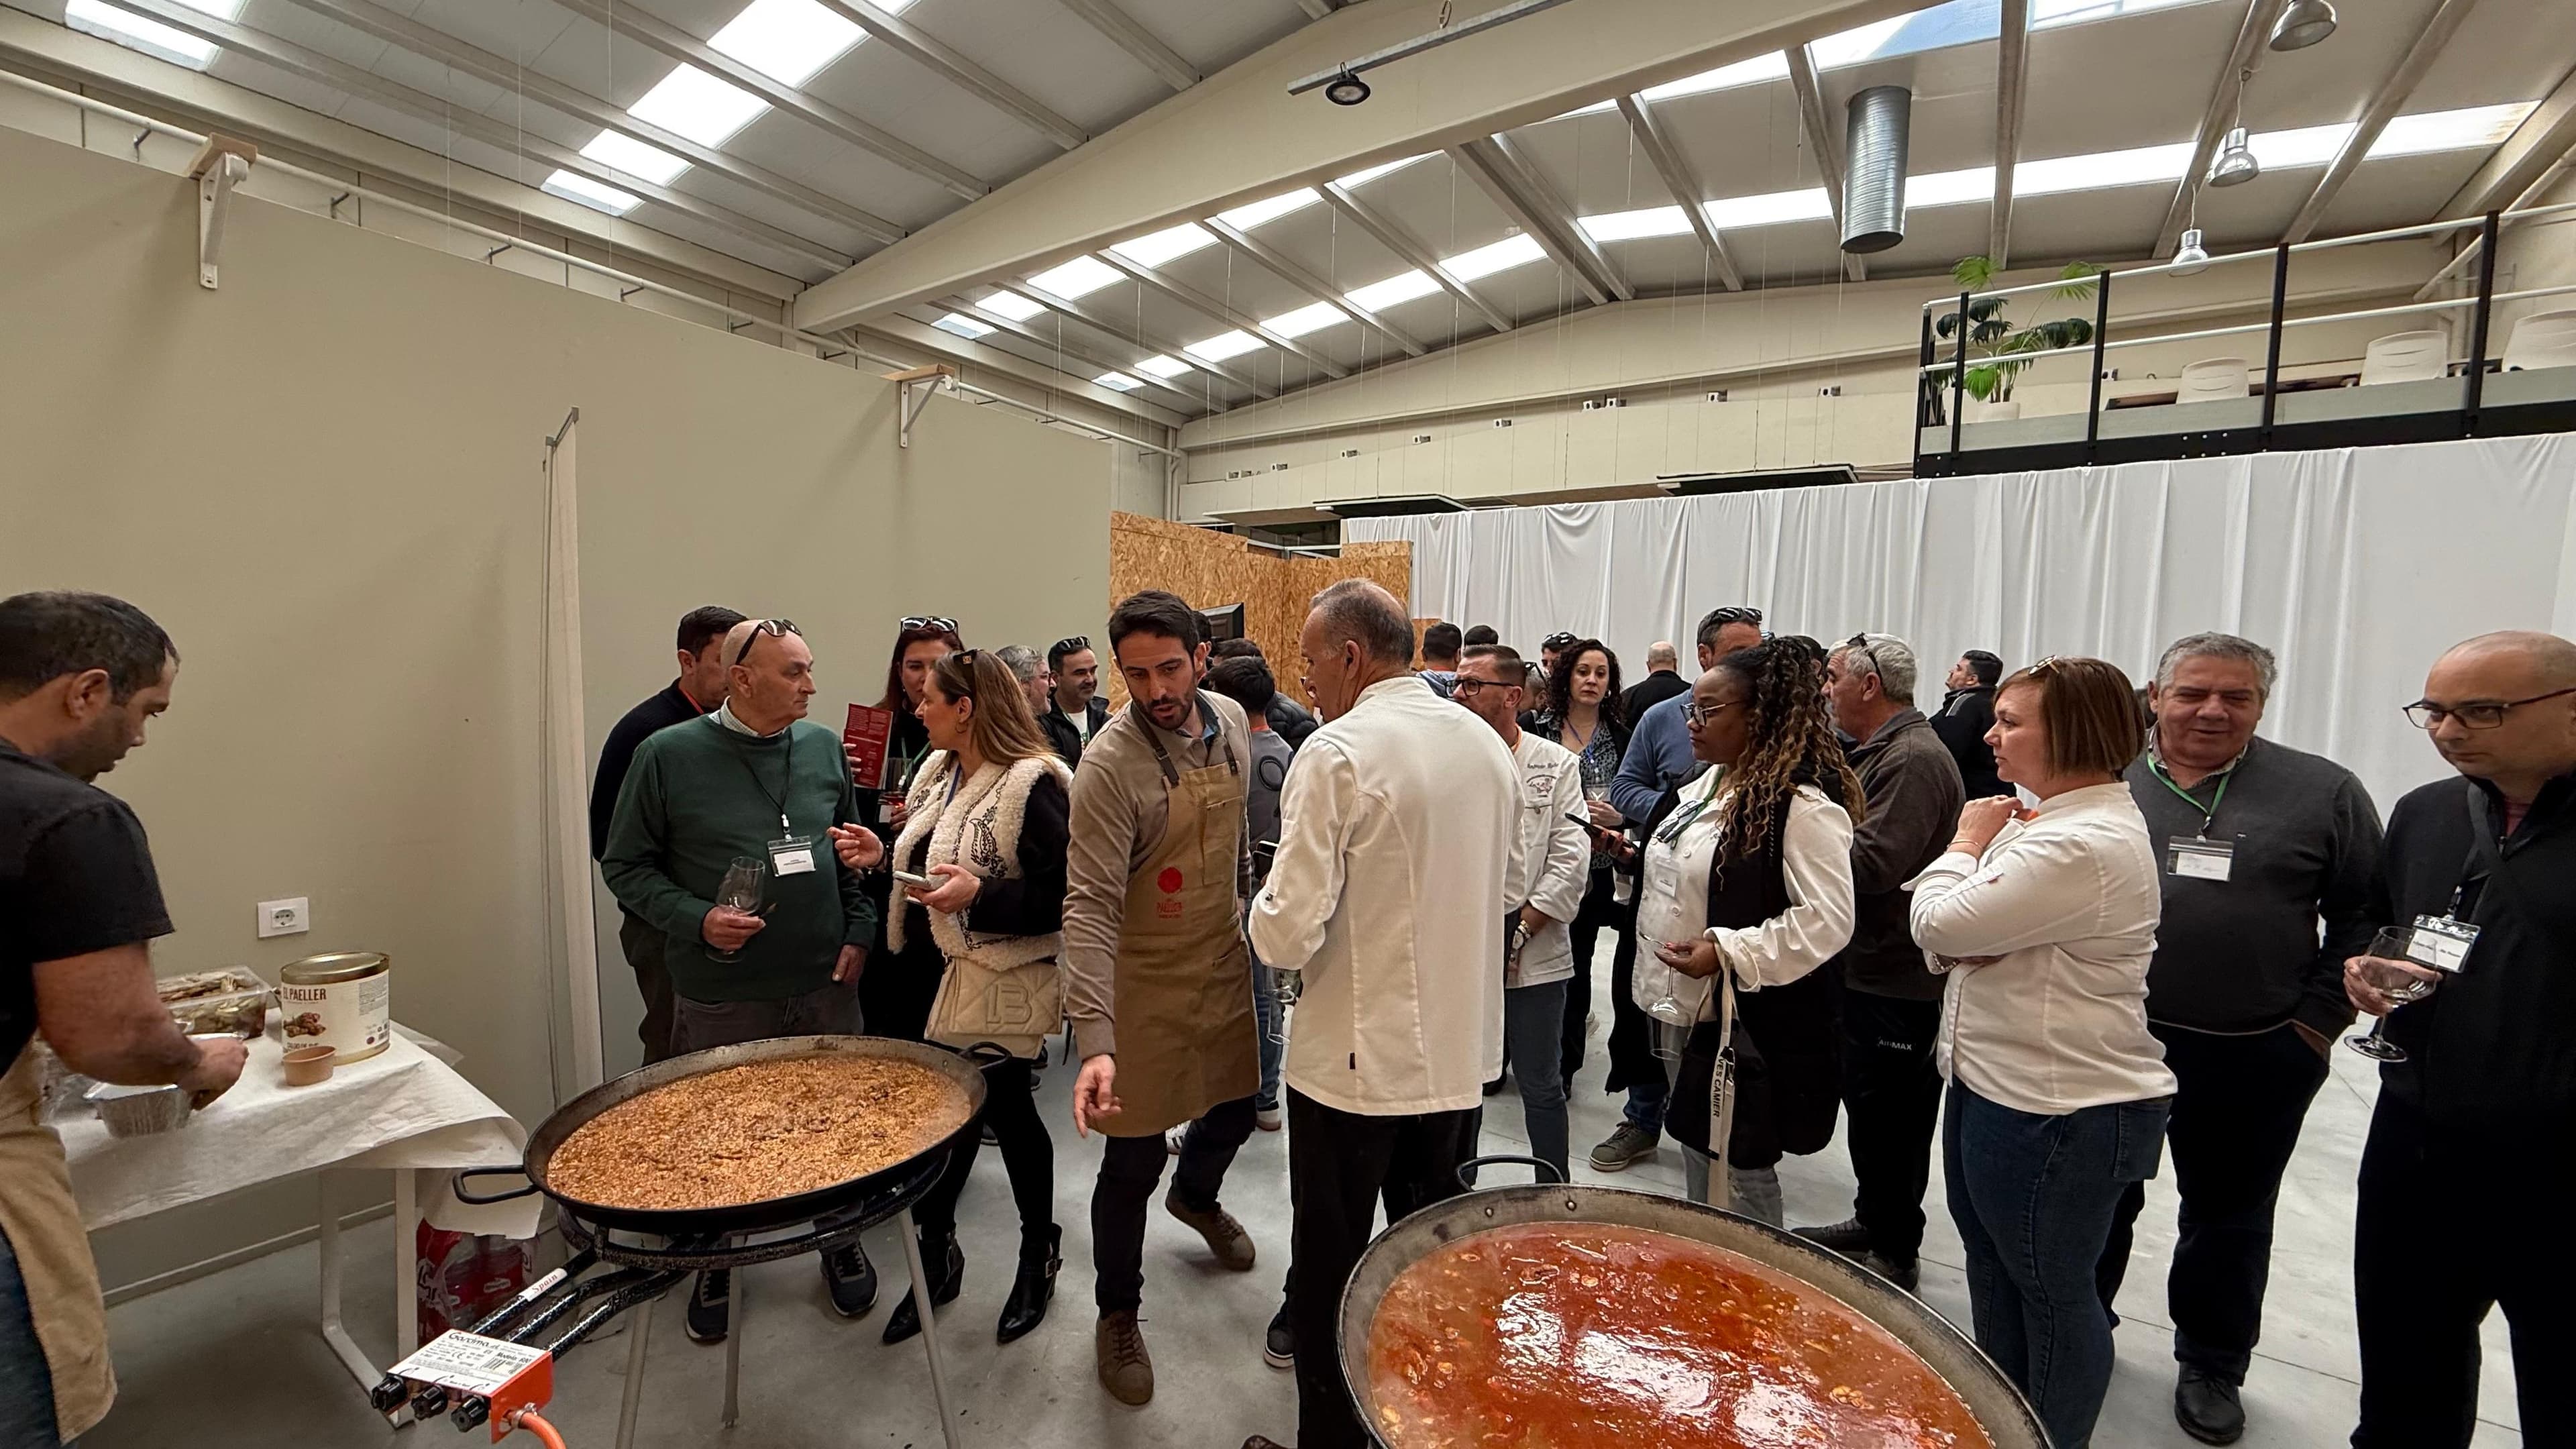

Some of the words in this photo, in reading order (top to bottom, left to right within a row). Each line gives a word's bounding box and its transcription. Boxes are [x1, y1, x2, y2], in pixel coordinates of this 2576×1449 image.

[289, 987, 327, 1001] PAELLER
[1712, 1079, 1721, 1118] CAMIER
[531, 1275, 558, 1293] Spain
